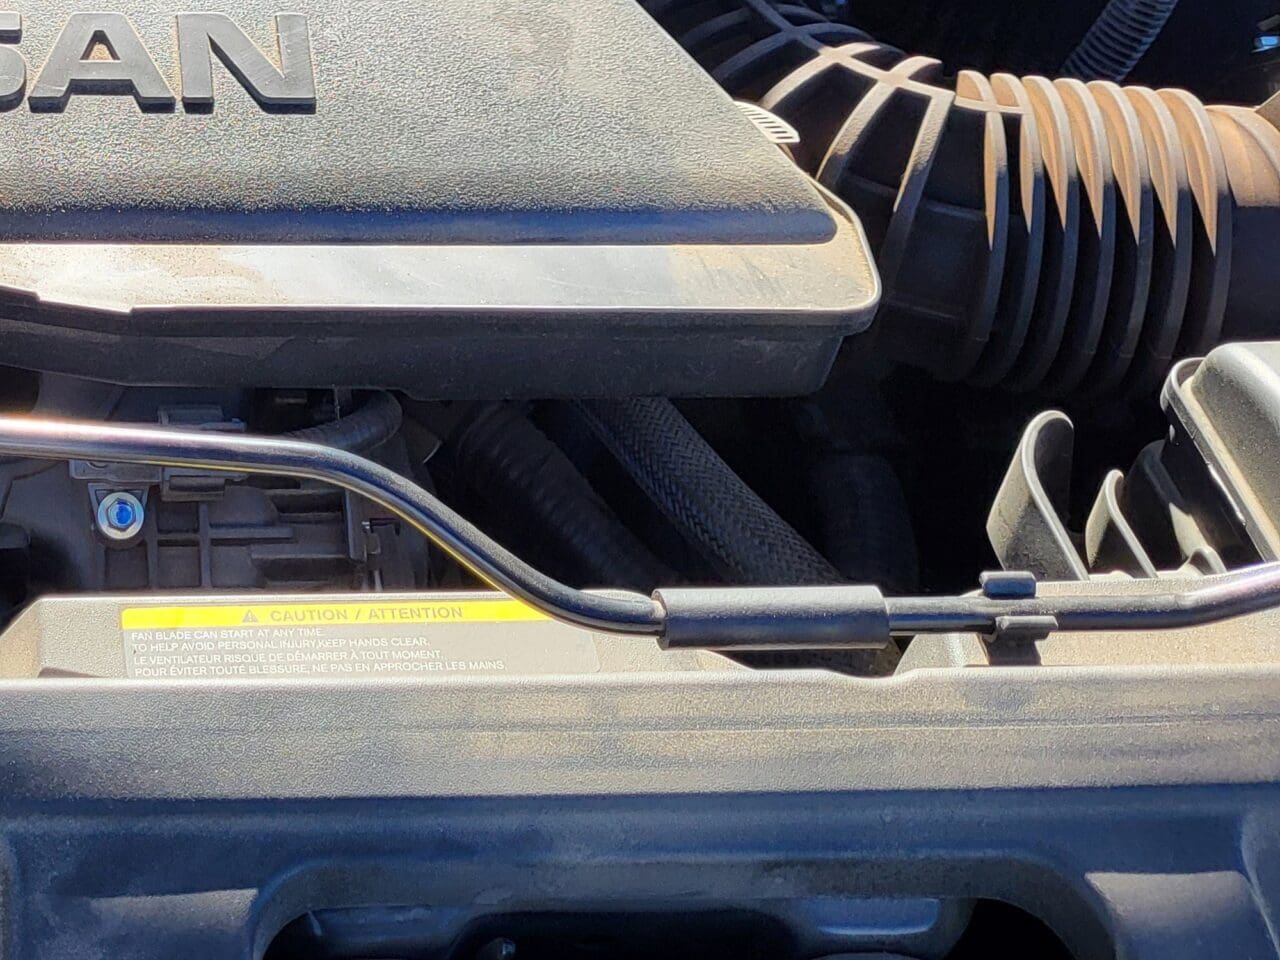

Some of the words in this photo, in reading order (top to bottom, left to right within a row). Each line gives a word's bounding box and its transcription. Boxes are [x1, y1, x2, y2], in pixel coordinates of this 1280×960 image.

[270, 609, 348, 622] CAUTION
[368, 606, 464, 620] ATTENTION
[131, 632, 152, 640] FAN
[156, 631, 191, 640] BLADE
[194, 630, 217, 639] CAN
[221, 630, 254, 638] START
[272, 629, 295, 637] ANY
[132, 643, 147, 652] TO
[150, 643, 178, 651] HELP
[181, 642, 214, 651] AVOID
[218, 640, 277, 649] PERSONAL
[320, 639, 346, 648] KEEP
[349, 638, 388, 647] HANDS
[391, 637, 430, 646] CLEAR.
[134, 656, 146, 665] LE
[149, 654, 221, 664] VENTILATEUR
[224, 654, 266, 663] RISQUE
[269, 652, 284, 662] DE
[287, 649, 347, 662] DÉMARRER
[350, 648, 358, 660] À
[361, 651, 389, 660] TOUT
[135, 667, 167, 676] POUR
[170, 664, 207, 676] ÉVITER
[210, 666, 245, 675] TOUTE
[249, 664, 310, 675] BLESSURE,
[313, 664, 328, 673] NE
[331, 664, 352, 672] PAS
[355, 664, 369, 672] EN
[373, 661, 442, 672] APPROCHER
[446, 662, 465, 671] LES
